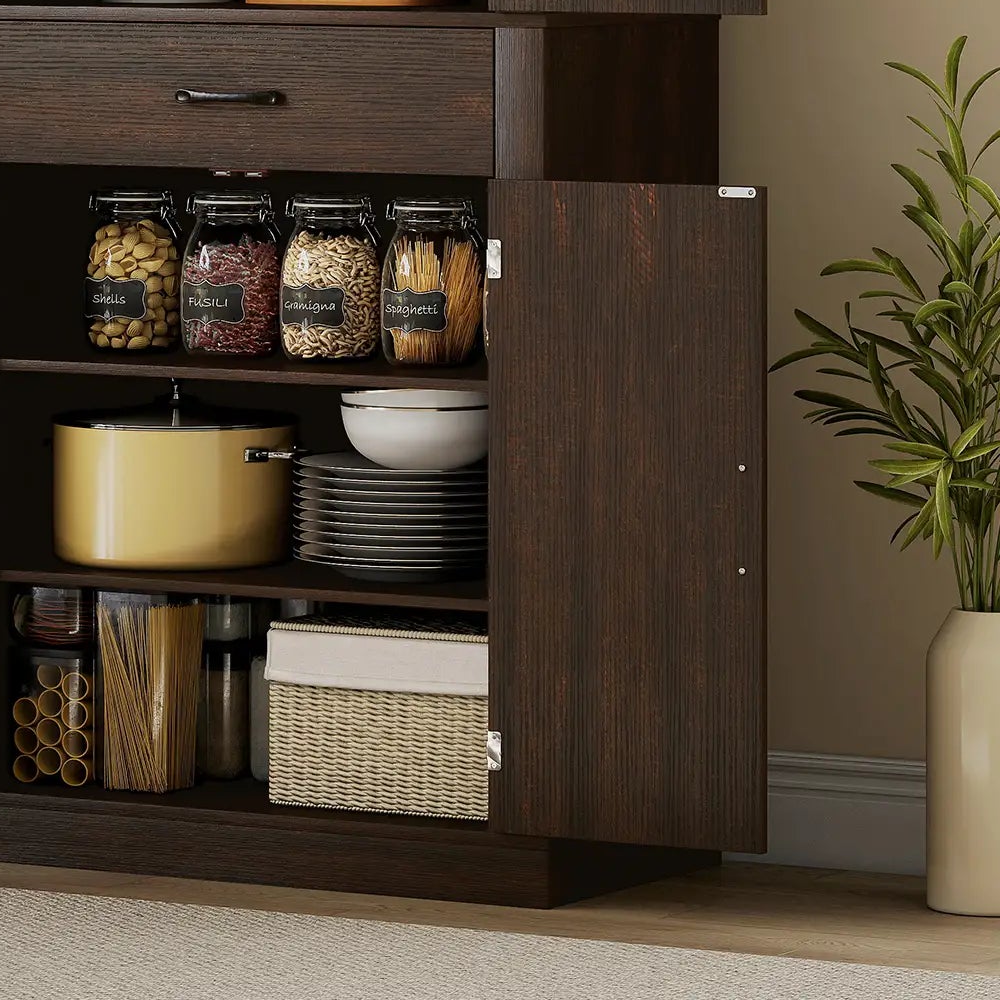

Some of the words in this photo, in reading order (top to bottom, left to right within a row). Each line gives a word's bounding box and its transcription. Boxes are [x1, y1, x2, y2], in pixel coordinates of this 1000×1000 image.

[92, 294, 126, 304] Shells
[284, 300, 336, 313] Gramigna
[385, 303, 439, 317] Spaghetti
